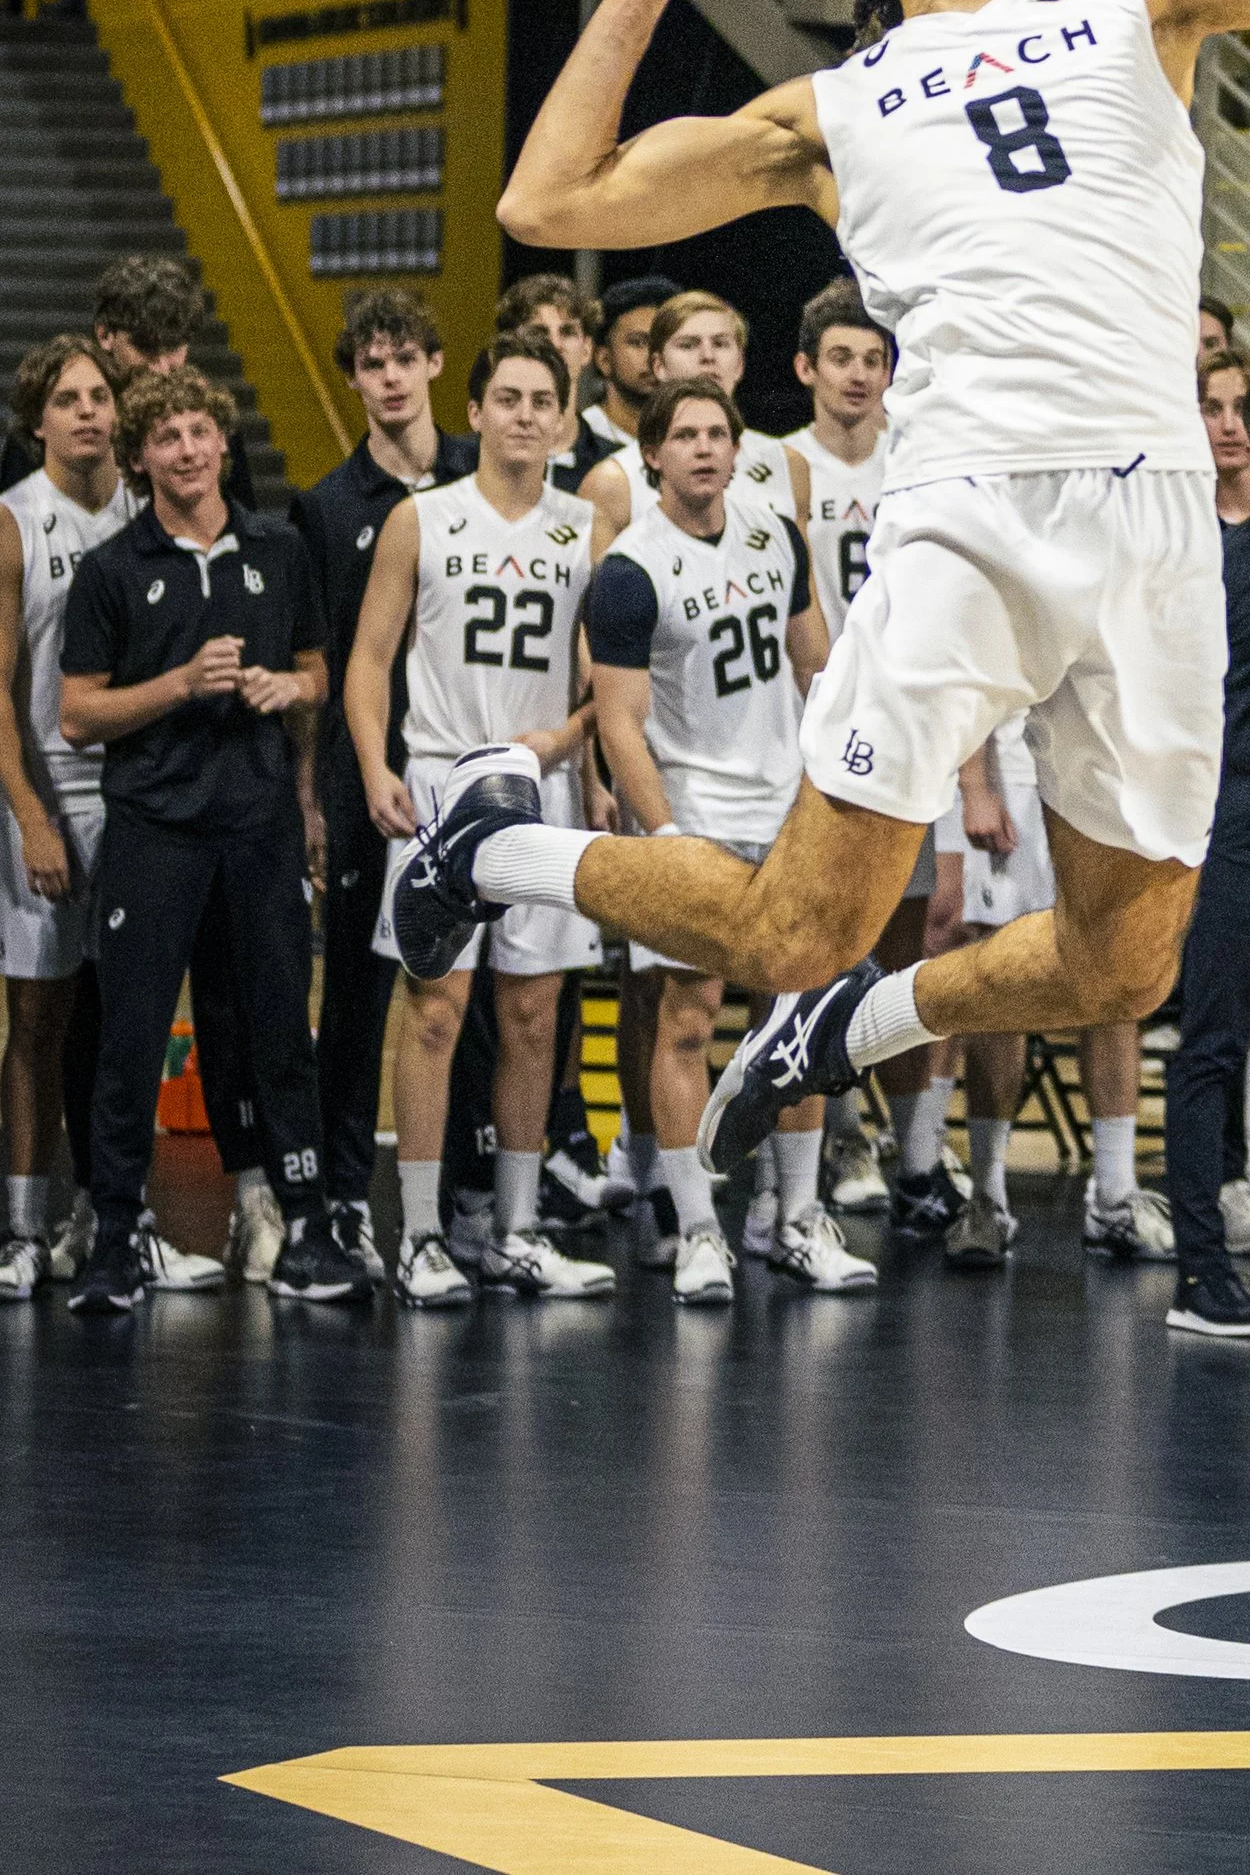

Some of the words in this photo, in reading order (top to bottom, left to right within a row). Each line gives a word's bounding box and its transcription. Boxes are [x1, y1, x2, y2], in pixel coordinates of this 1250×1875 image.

[877, 19, 1098, 118] BEACH
[964, 85, 1073, 194] 8
[446, 553, 571, 588] BEACH
[682, 568, 785, 621] BEACH
[463, 584, 554, 673] 22
[708, 602, 781, 699] 26
[839, 727, 874, 776] LB
[283, 1147, 319, 1183] 28
